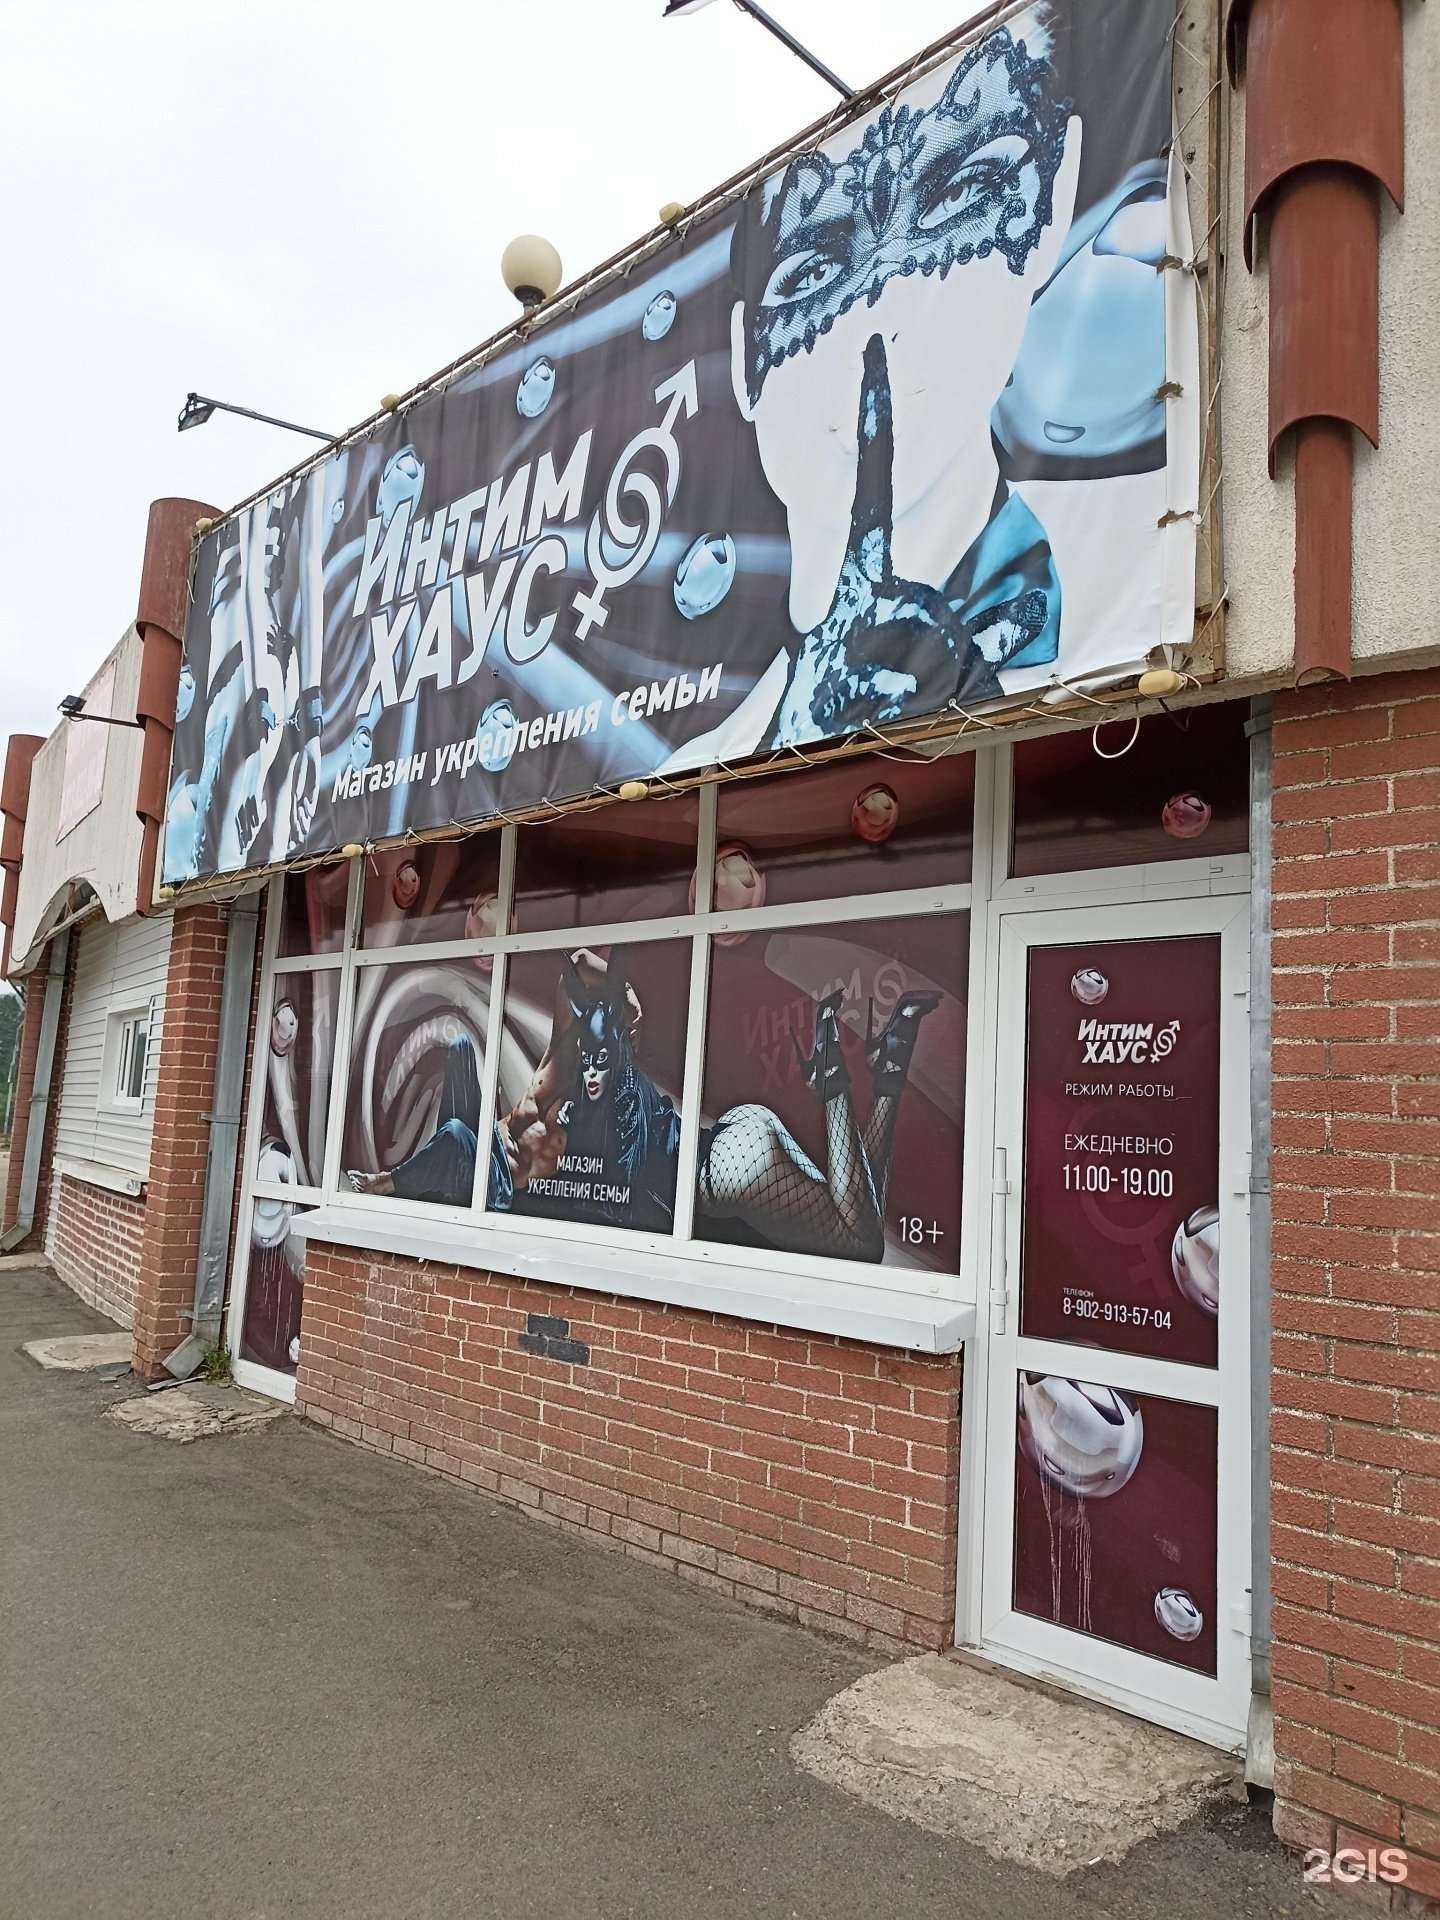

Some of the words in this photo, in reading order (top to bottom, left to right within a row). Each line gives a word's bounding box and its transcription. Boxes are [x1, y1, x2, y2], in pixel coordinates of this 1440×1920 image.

[355, 534, 568, 717] ХАУС
[331, 750, 428, 803] Магазин
[430, 700, 602, 786] укрепления
[609, 662, 724, 727] семьи
[1081, 1041, 1148, 1064] ХАУС
[1064, 1082, 1114, 1096] РЕЖИМ
[1118, 1083, 1174, 1098] РАБОТЫ
[1063, 1133, 1173, 1156] ЕЖЕДНЕВНО
[556, 1155, 604, 1174] МАГАЗИН
[527, 1177, 591, 1199] УКРЕПЛЕНИЯ
[593, 1183, 630, 1204] СЕМЬИ
[1062, 1164, 1173, 1198] 11.00-19.00
[898, 1216, 945, 1244] 18+
[1062, 1287, 1095, 1298] ТЕЛЕФОН
[1062, 1297, 1172, 1330] 8-902-913-57-04
